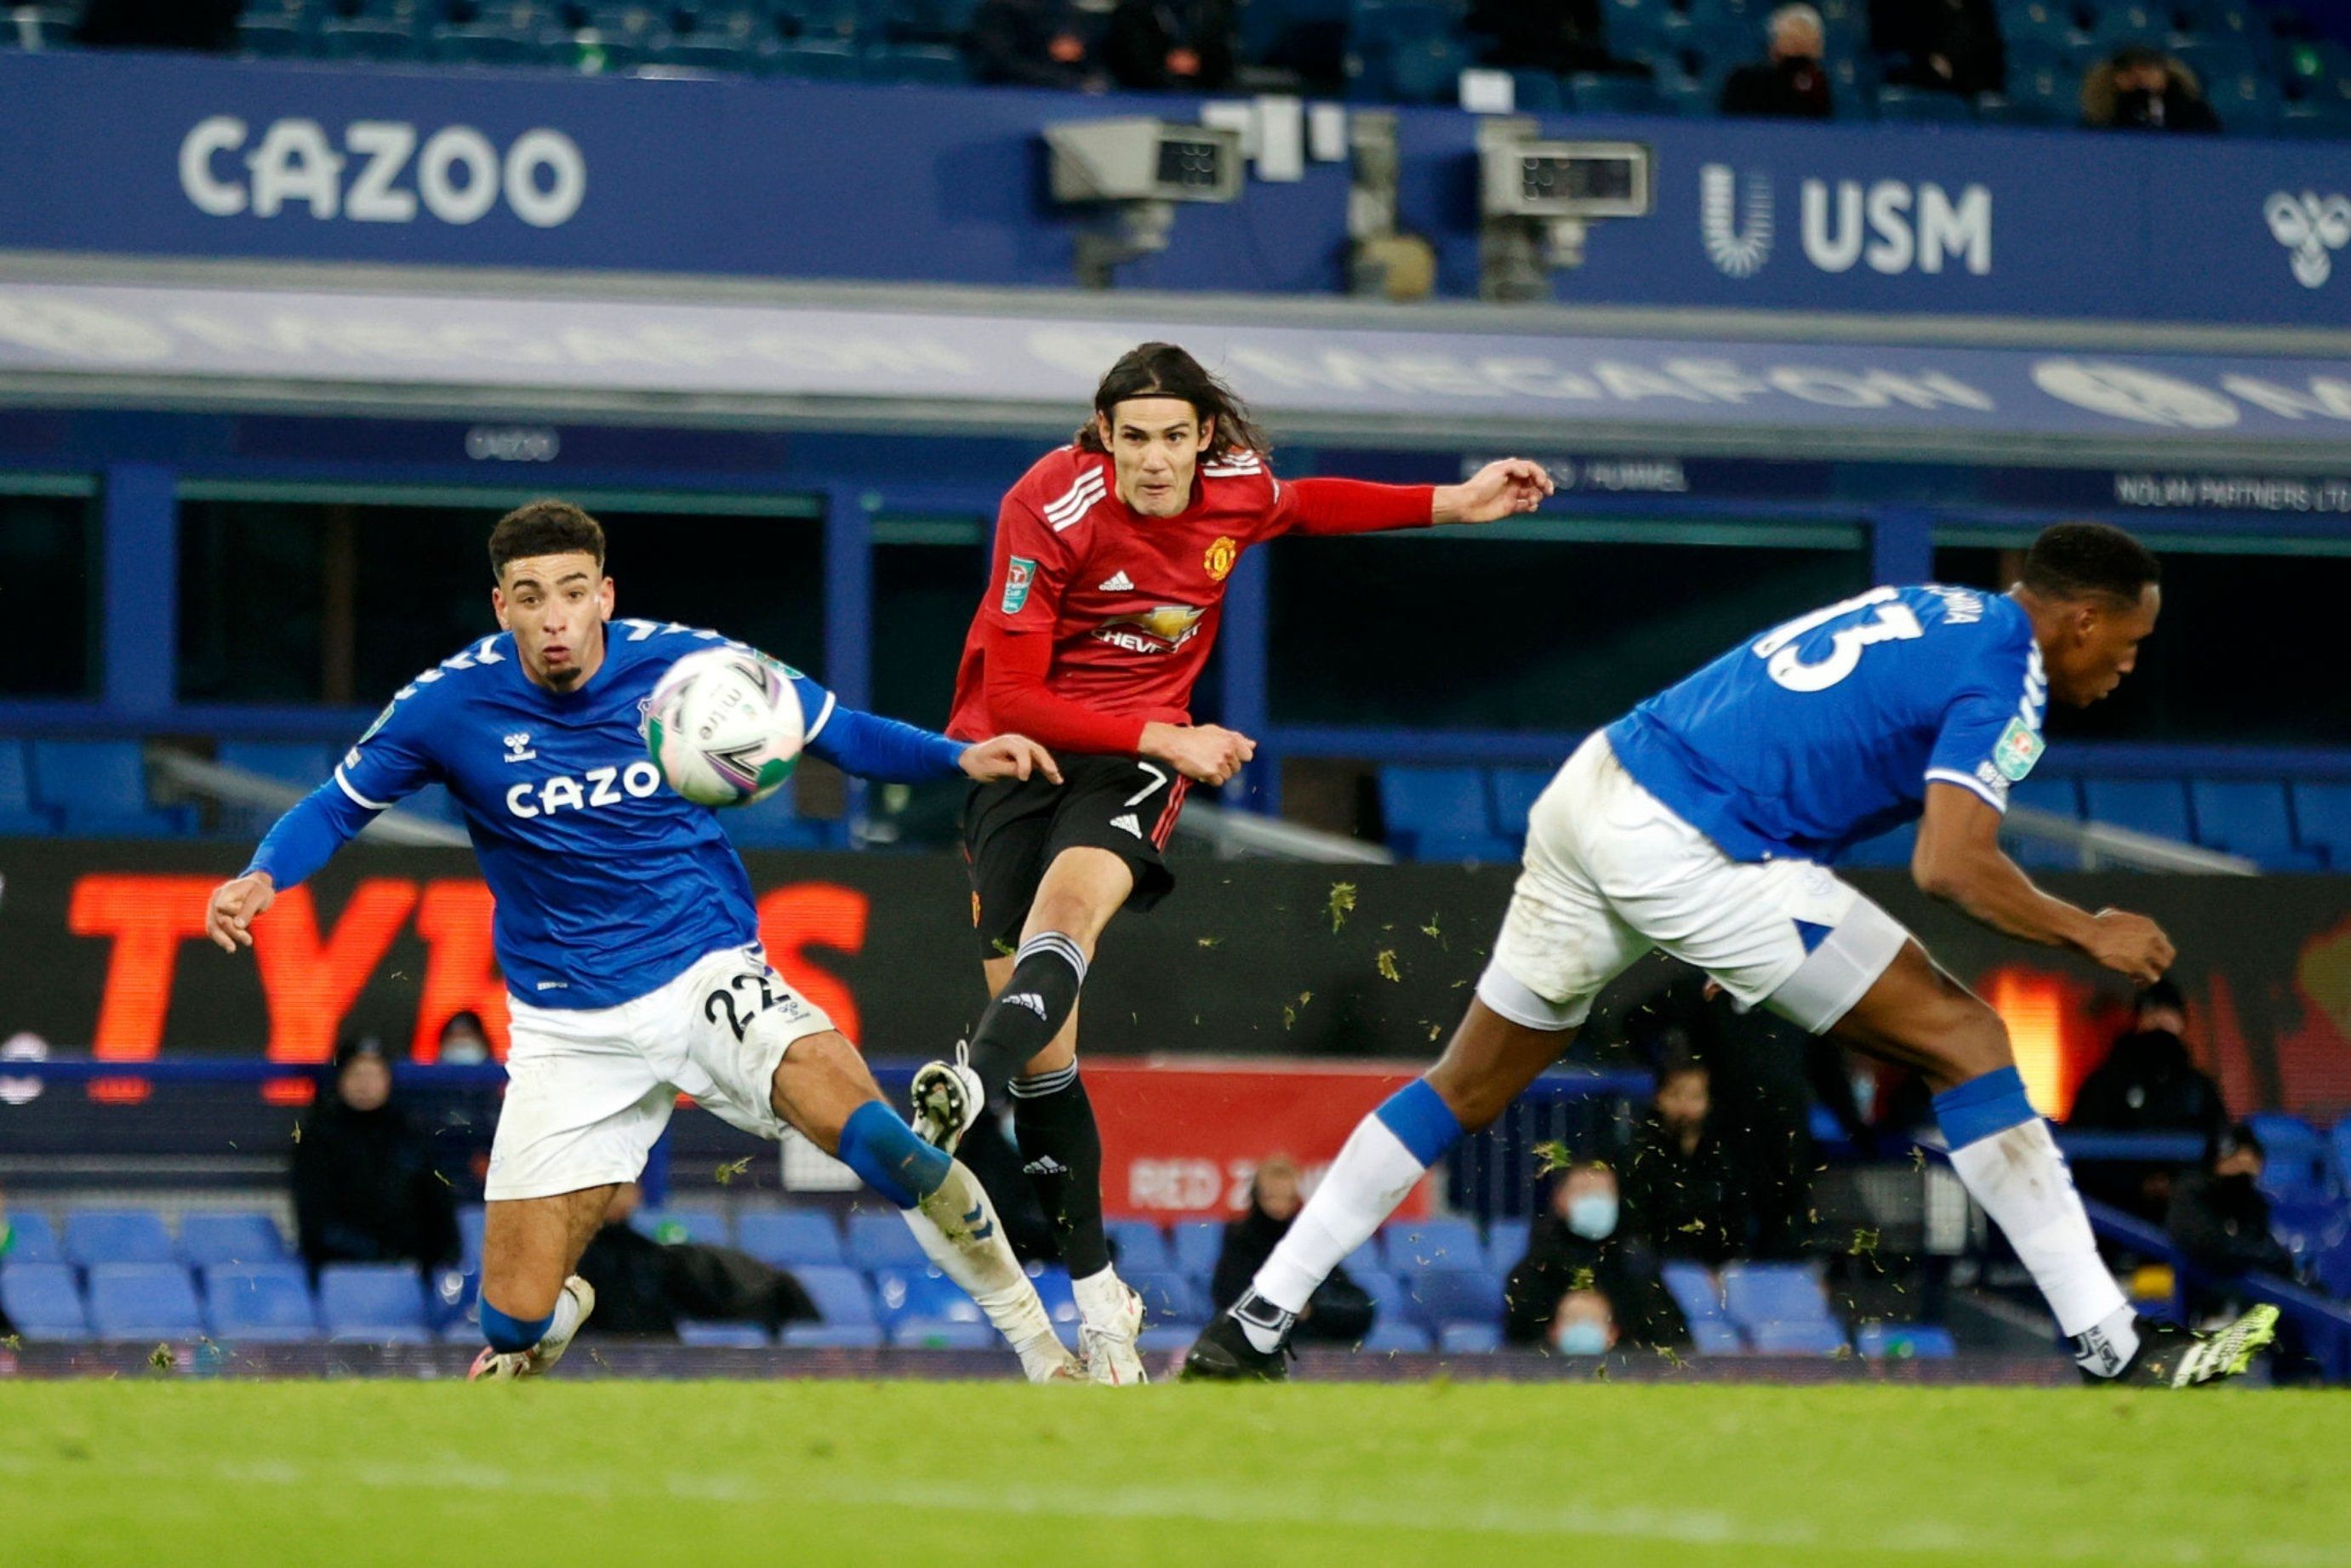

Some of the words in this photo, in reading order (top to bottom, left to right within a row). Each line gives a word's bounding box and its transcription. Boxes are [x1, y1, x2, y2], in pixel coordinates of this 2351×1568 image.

[179, 116, 587, 229] CAZOO
[1800, 177, 1993, 277] USM
[1751, 584, 1924, 693] 13
[506, 761, 660, 818] CAZO
[1123, 761, 1167, 807] 7
[68, 873, 867, 1104] TYRS
[705, 973, 790, 1043] 22
[1128, 1157, 1223, 1210] RED
